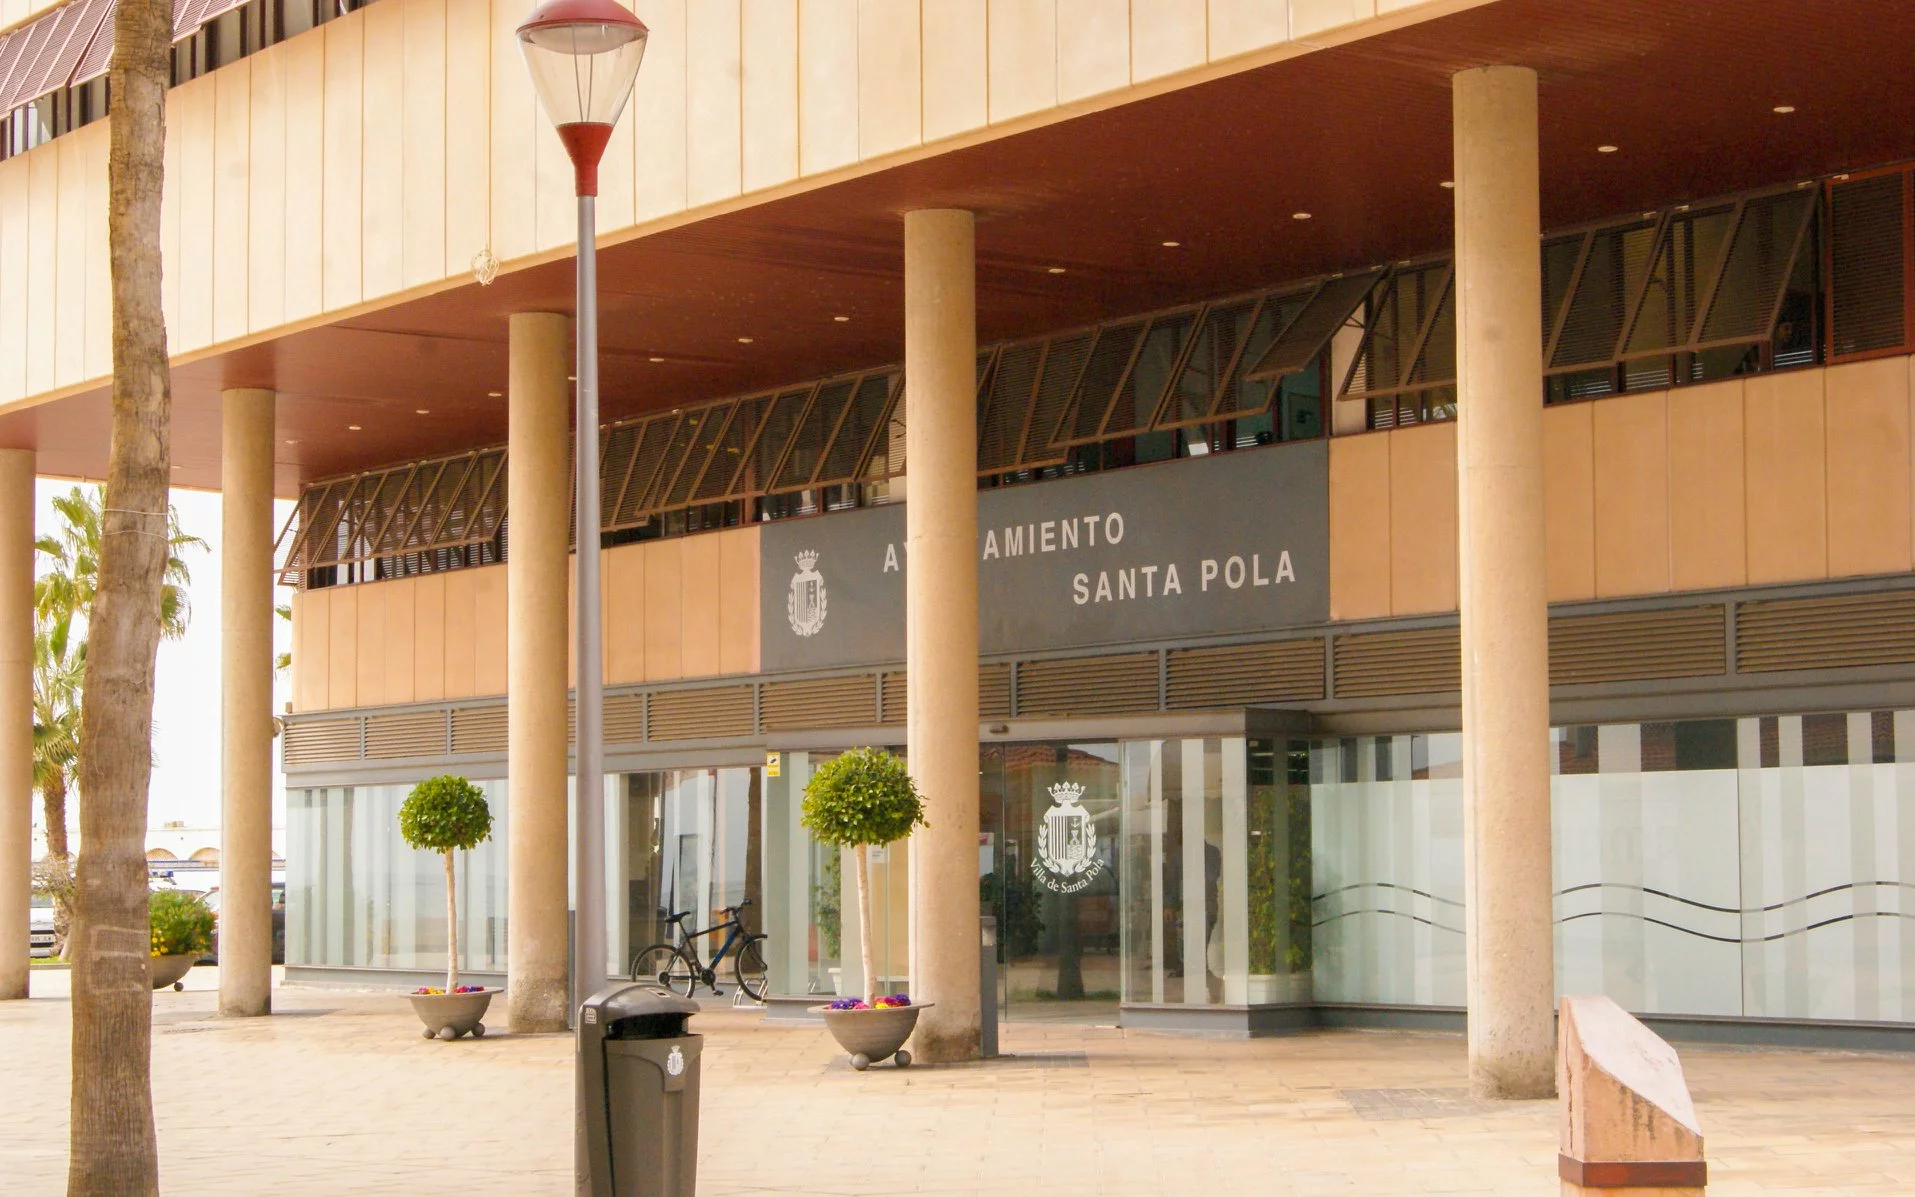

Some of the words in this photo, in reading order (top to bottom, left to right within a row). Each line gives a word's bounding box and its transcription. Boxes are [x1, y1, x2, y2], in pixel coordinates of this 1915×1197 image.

[883, 512, 1124, 573] AAMIENTO
[1073, 563, 1182, 605] SANTA
[1201, 550, 1296, 592] POLA
[1030, 857, 1049, 884] Villa
[1047, 878, 1060, 892] de
[1061, 878, 1088, 894] Santa
[1085, 858, 1105, 881] Pola
